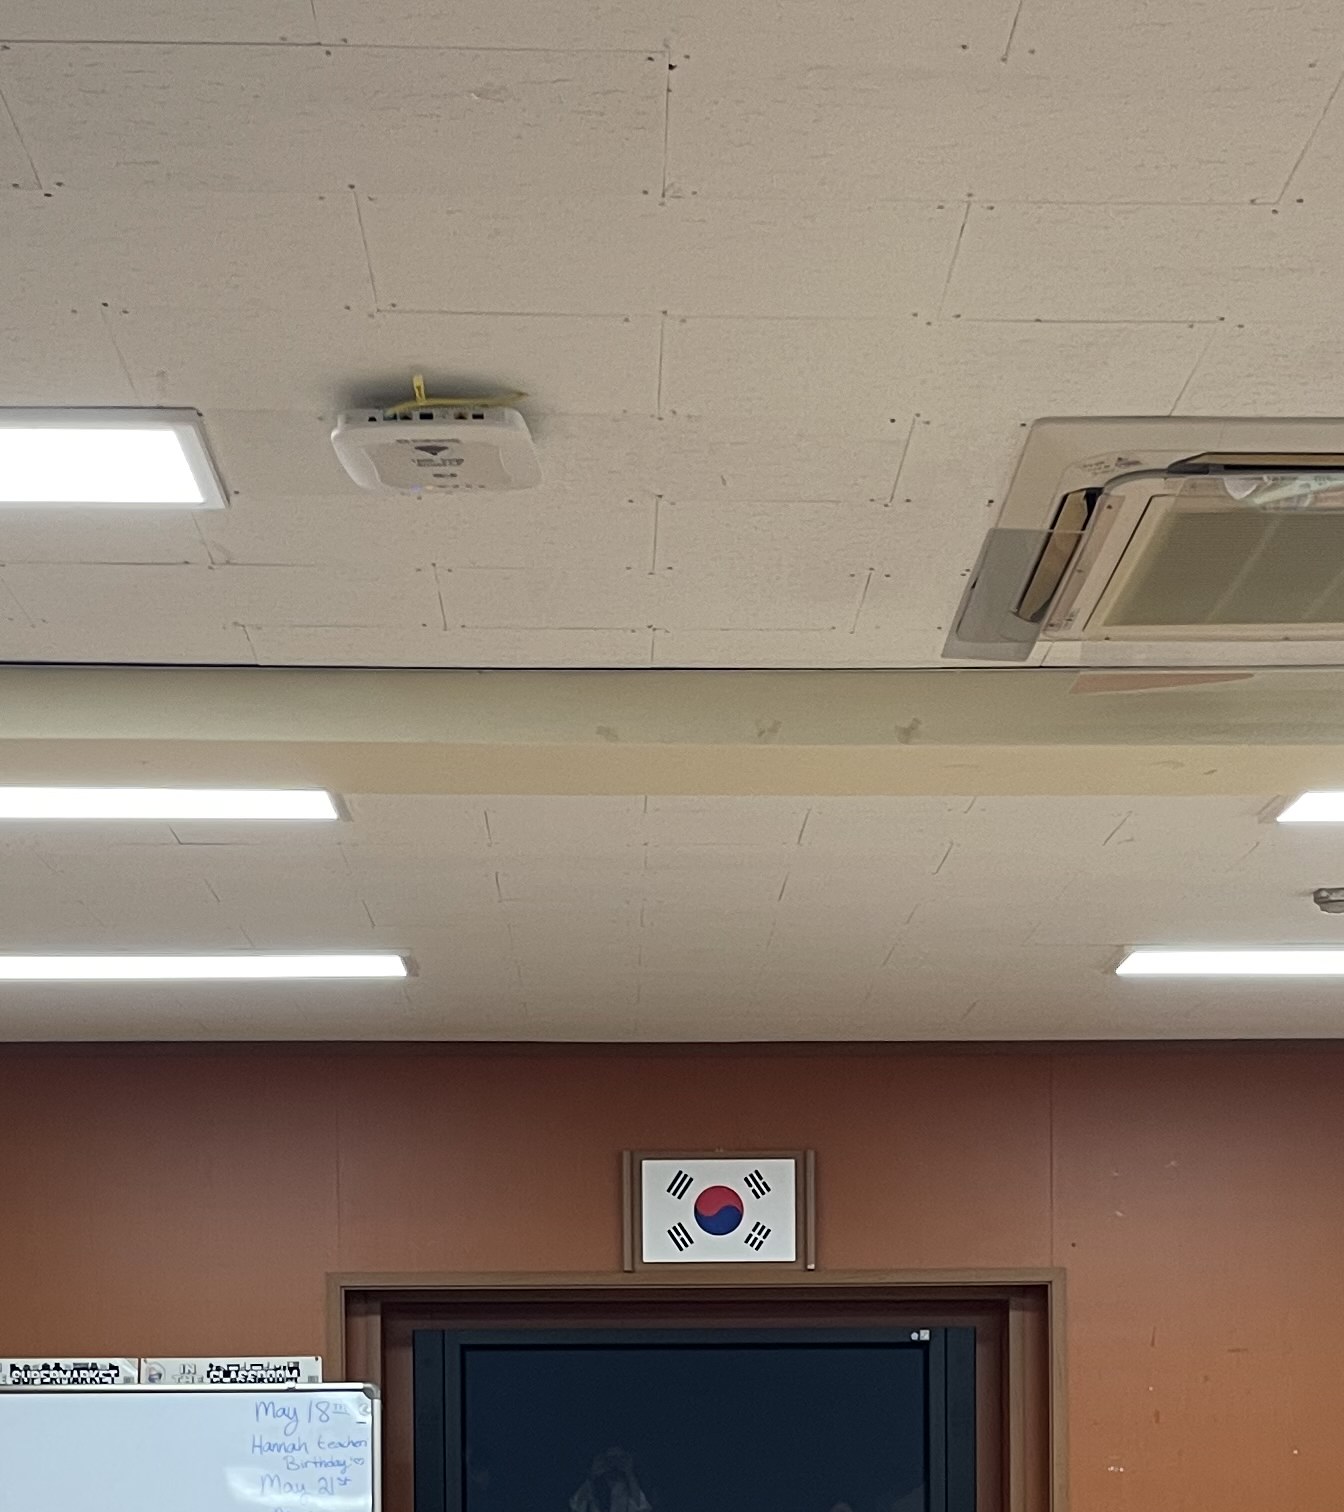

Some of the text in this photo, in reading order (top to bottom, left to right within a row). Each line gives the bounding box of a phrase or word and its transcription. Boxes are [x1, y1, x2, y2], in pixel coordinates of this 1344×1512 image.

[181, 1363, 196, 1374] IN
[11, 1370, 119, 1384] SUPERMARKET
[209, 1369, 299, 1384] CLASSROOM
[256, 1401, 299, 1437] May
[251, 1434, 309, 1455] Hannah
